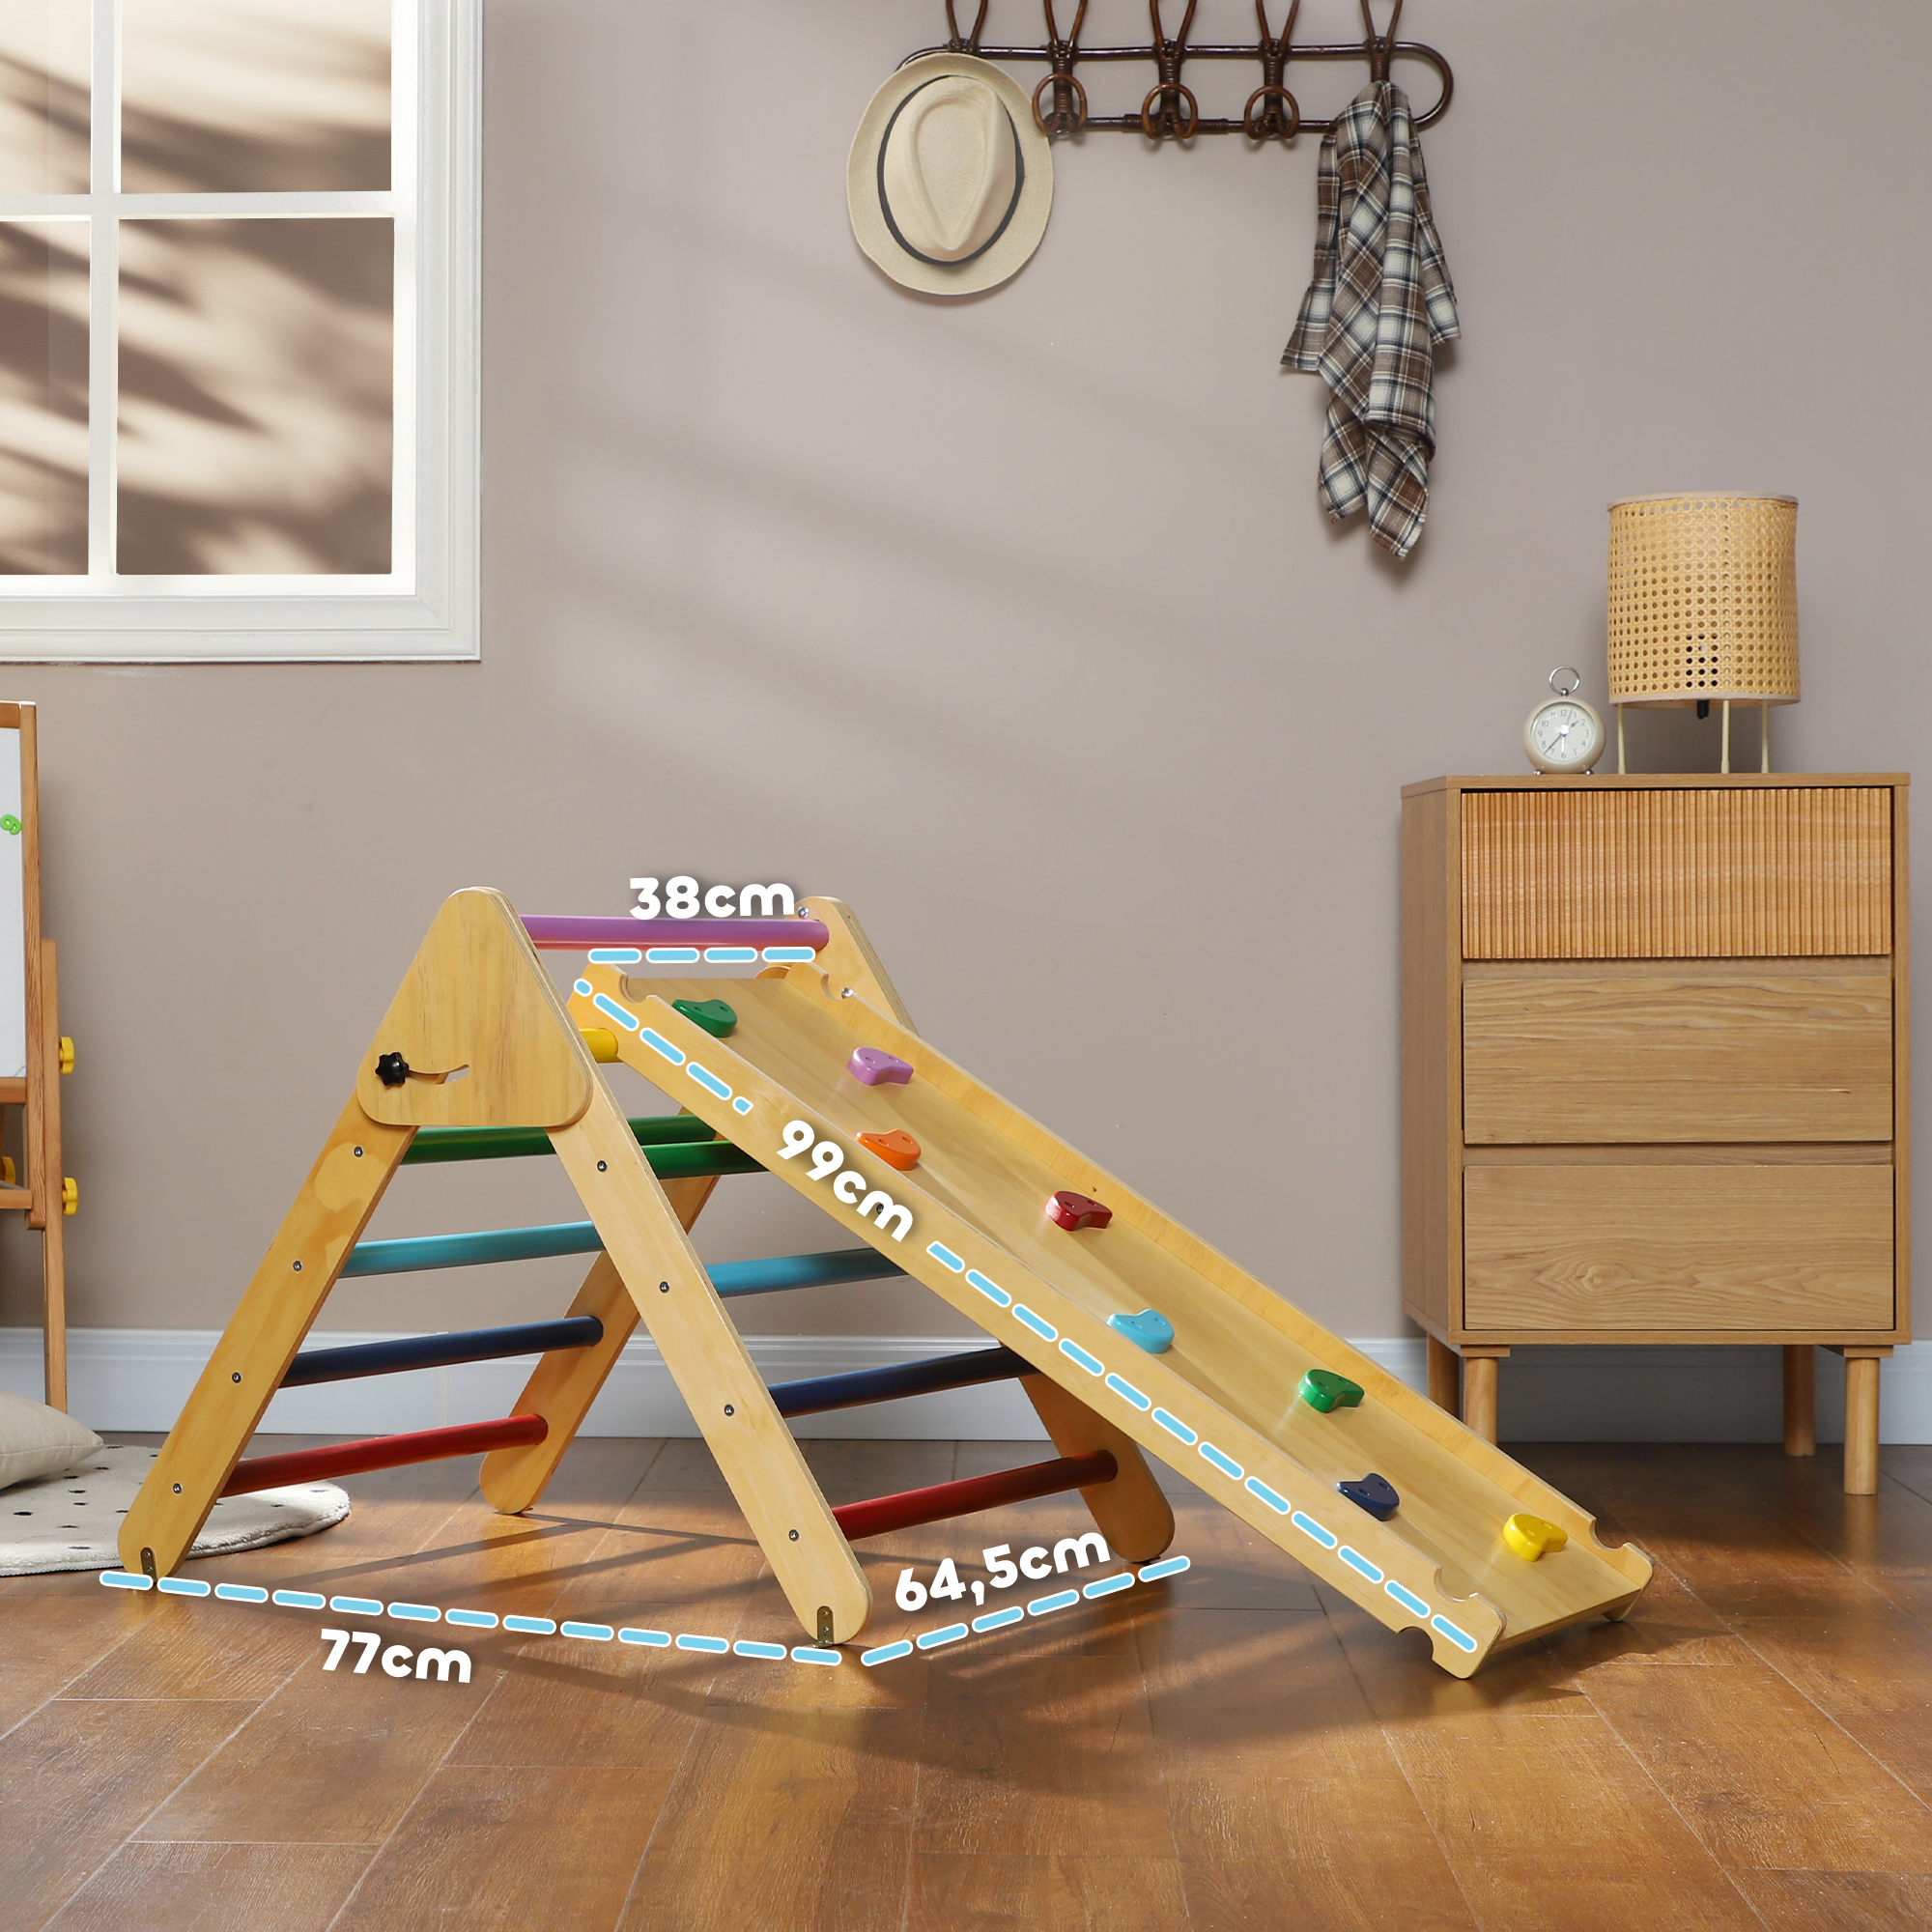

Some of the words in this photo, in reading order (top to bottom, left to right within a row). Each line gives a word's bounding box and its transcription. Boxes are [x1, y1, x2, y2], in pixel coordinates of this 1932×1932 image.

[1560, 708, 1568, 717] 12
[1581, 718, 1586, 726] 2
[1537, 729, 1543, 738] 9
[1584, 728, 1590, 738] 3
[1541, 740, 1547, 749] 8
[1580, 739, 1586, 748] 4
